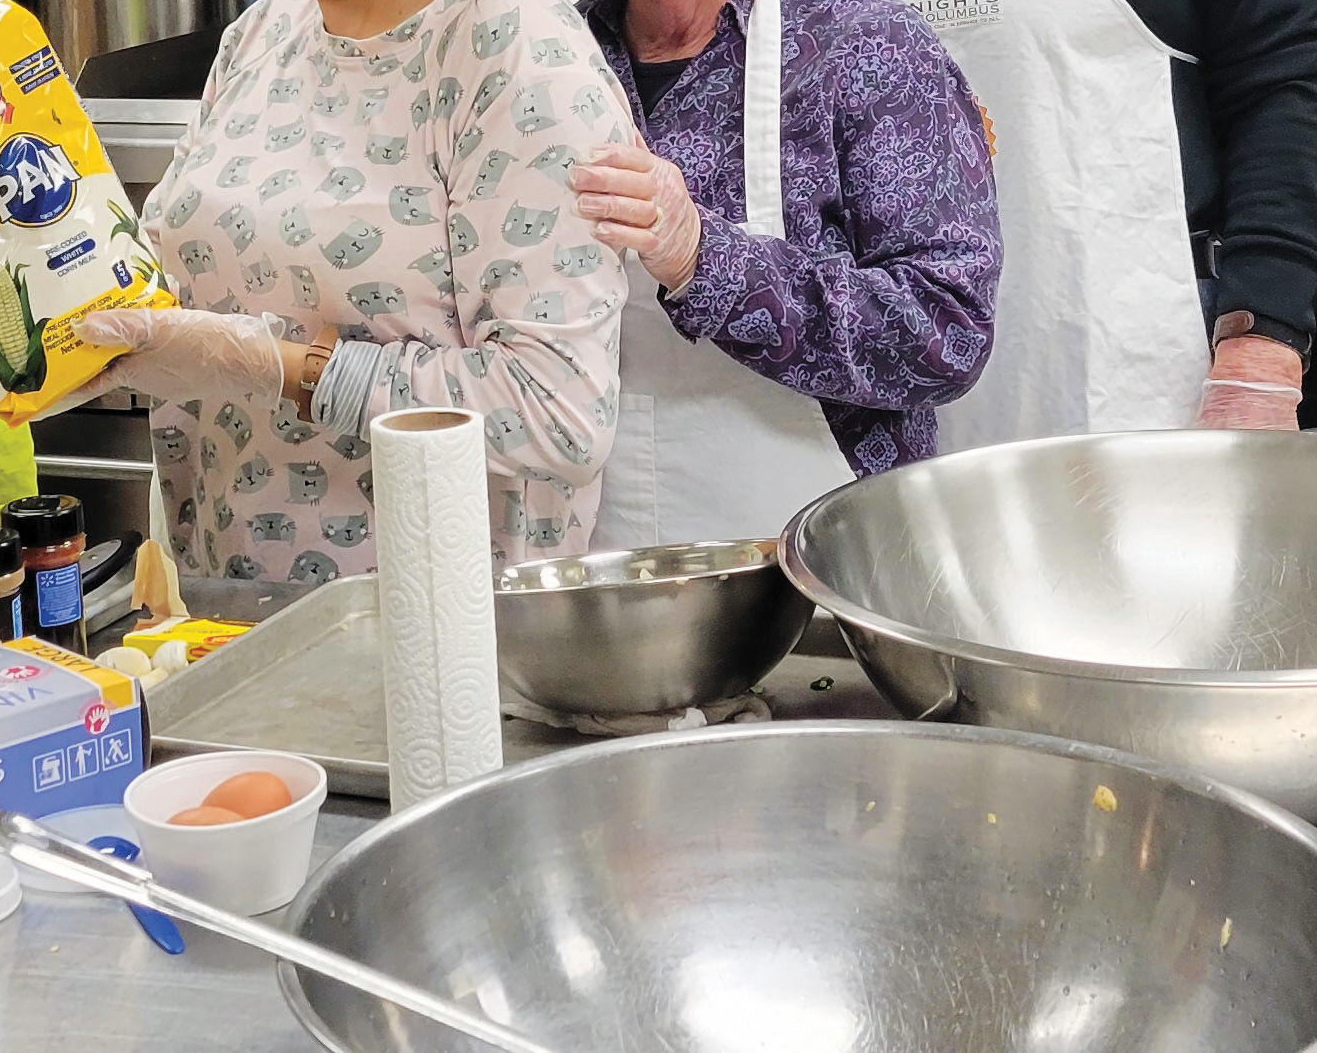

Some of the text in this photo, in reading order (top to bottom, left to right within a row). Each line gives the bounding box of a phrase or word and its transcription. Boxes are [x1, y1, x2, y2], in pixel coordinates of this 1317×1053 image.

[925, 4, 1000, 23] OLUMBUS
[60, 245, 85, 263] WHITE
[57, 253, 98, 278] CORN MEAL
